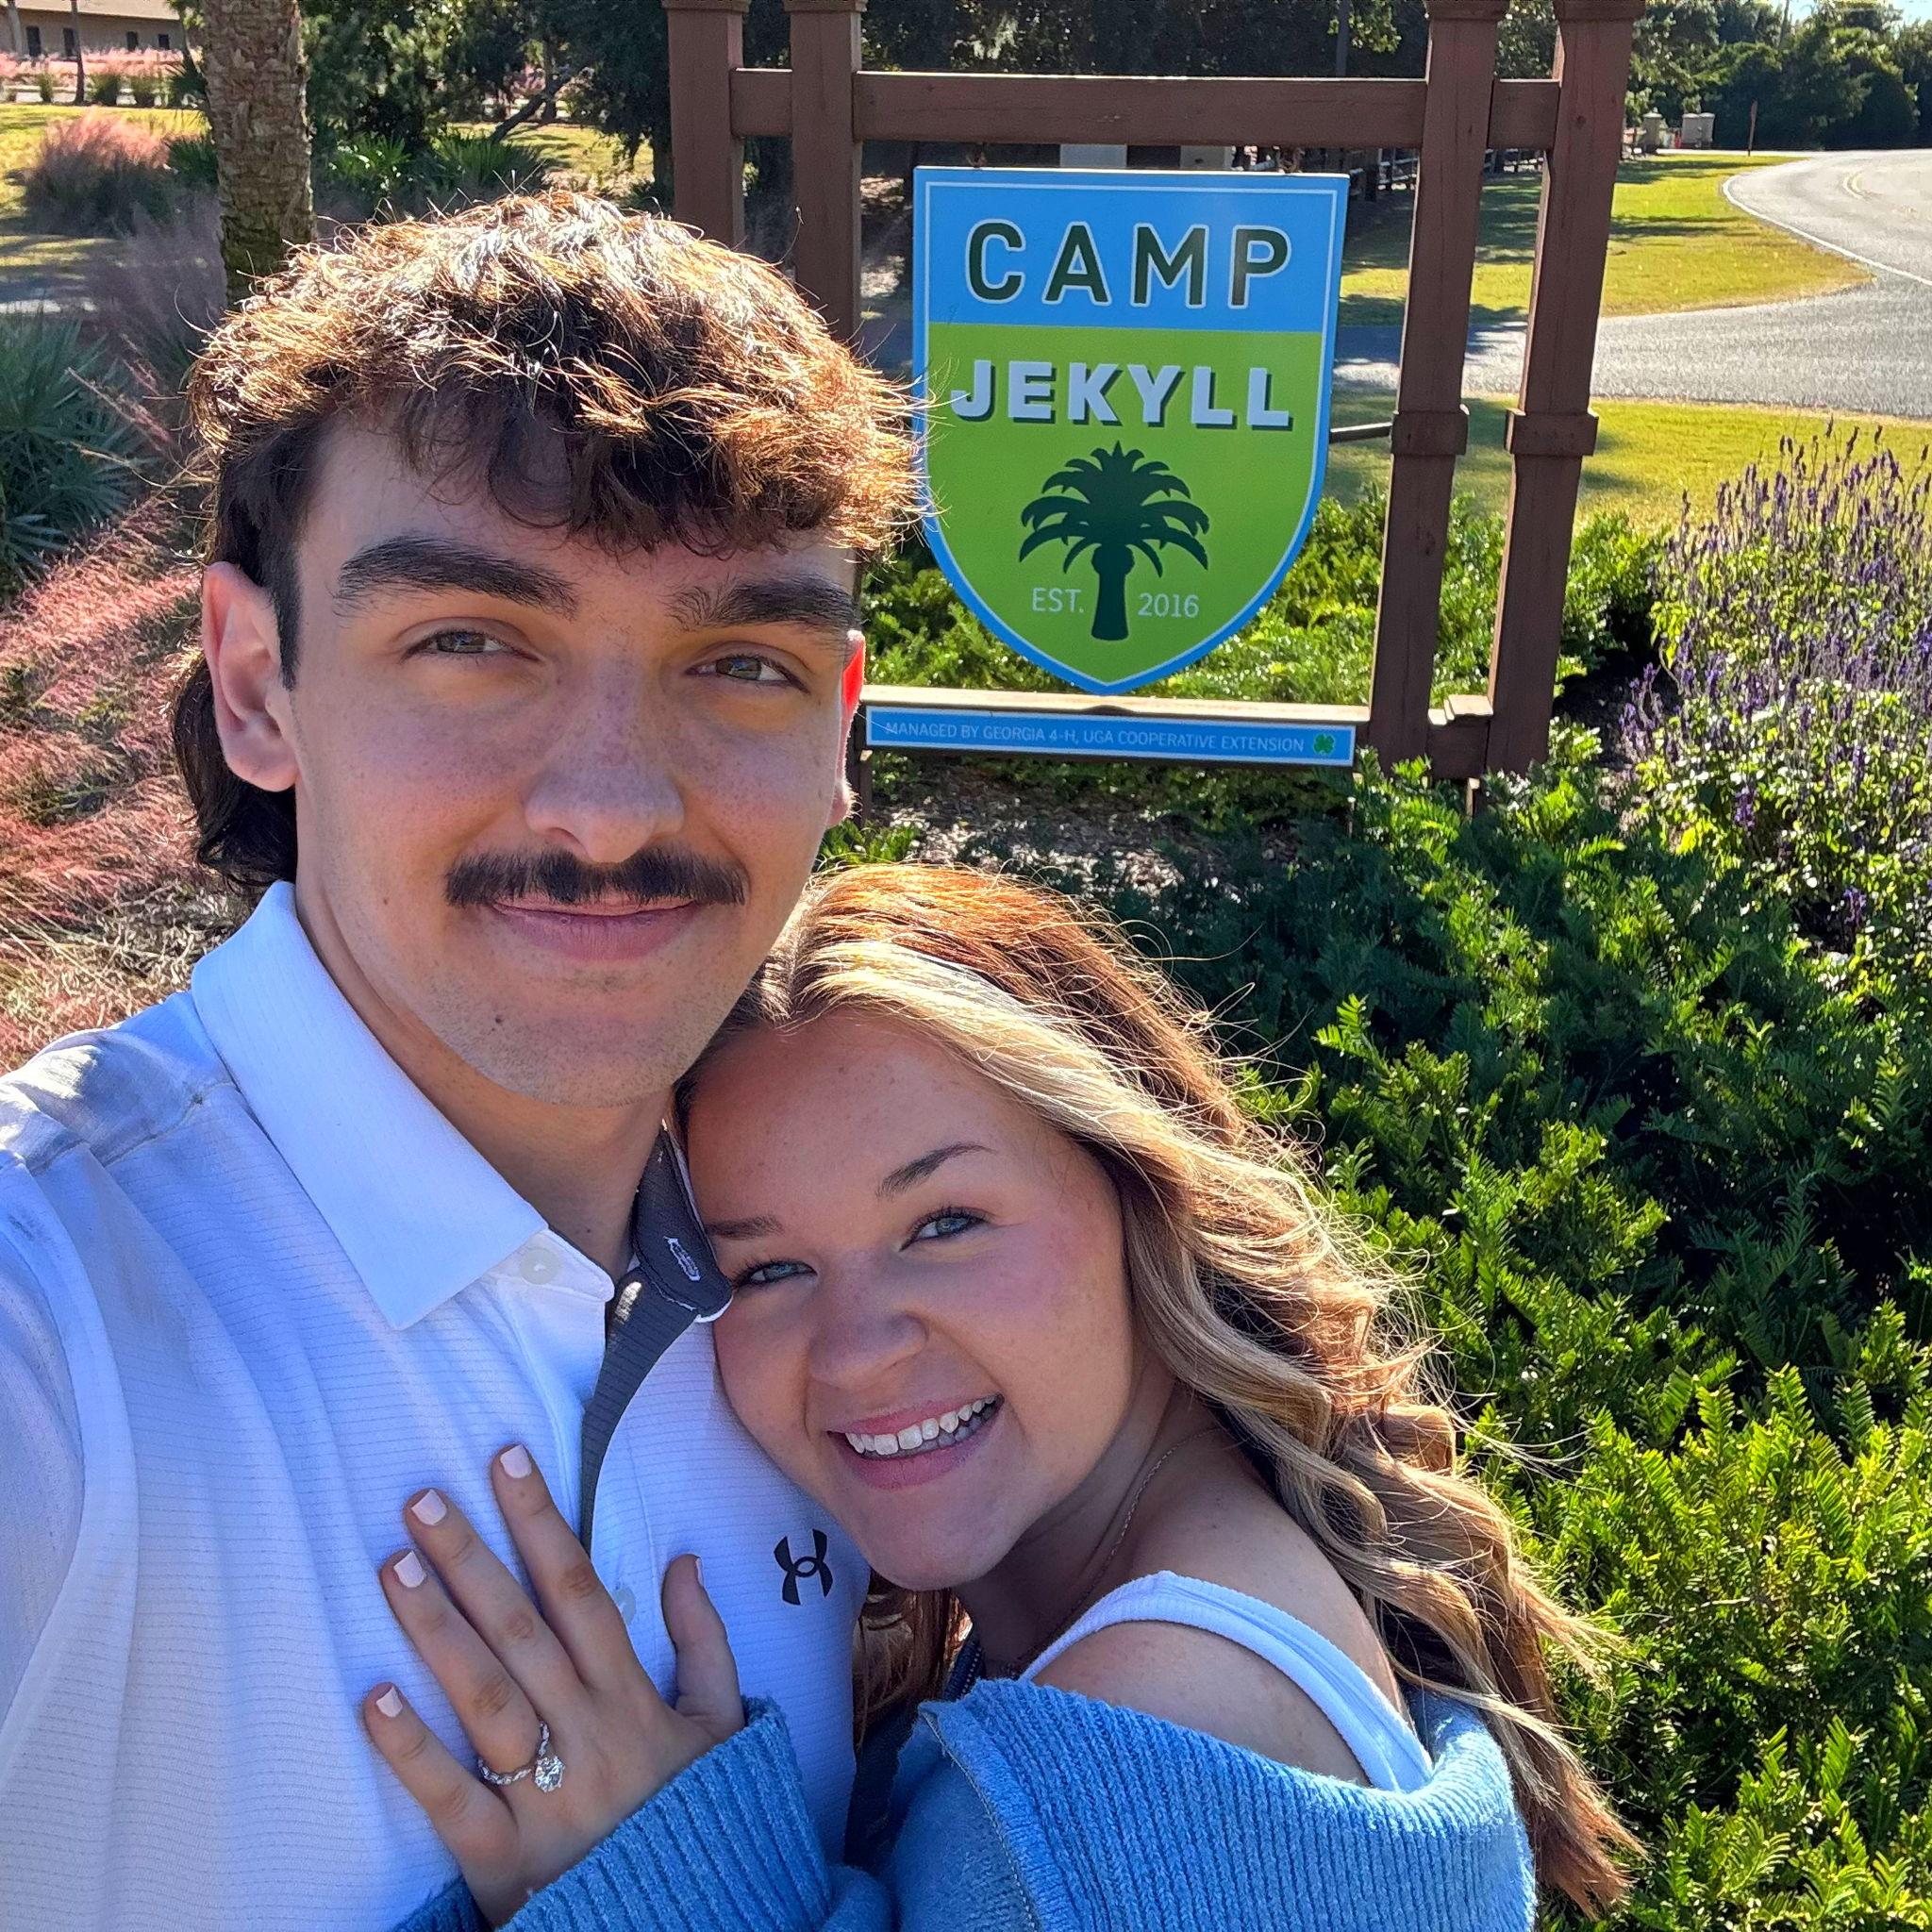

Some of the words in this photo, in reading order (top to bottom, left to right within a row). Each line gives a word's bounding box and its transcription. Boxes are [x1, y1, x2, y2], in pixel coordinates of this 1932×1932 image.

[966, 219, 1291, 309] CAMP
[950, 359, 1293, 431] JEKYLL
[1032, 588, 1084, 613] EST.
[1138, 592, 1199, 618] 2016
[885, 722, 958, 739] MANAGED
[961, 724, 979, 739] BY
[983, 724, 1045, 741] GEORGIA
[1084, 727, 1114, 743] UGA
[1118, 730, 1217, 749] COOPERATIVE
[1221, 735, 1305, 752] EXTENSION
